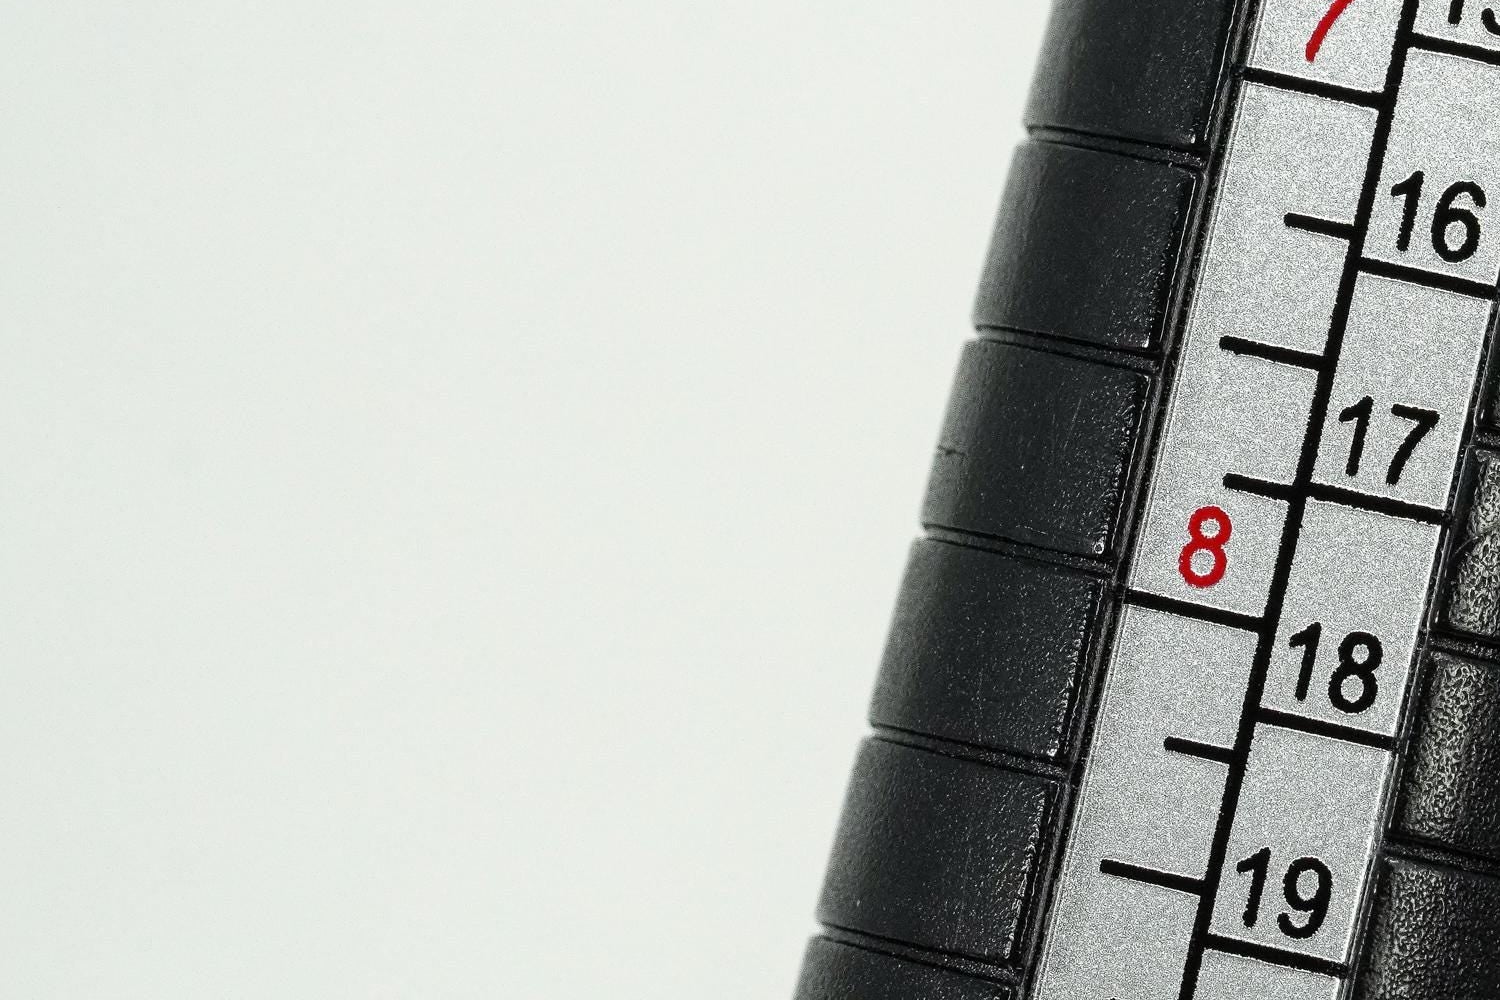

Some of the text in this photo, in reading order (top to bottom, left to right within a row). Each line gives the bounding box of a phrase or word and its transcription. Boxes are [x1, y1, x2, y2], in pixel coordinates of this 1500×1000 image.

[1391, 171, 1486, 263] 16
[1338, 396, 1440, 487] 17
[1178, 506, 1232, 589] 8
[1289, 622, 1383, 714] 18
[1236, 847, 1333, 939] 19
